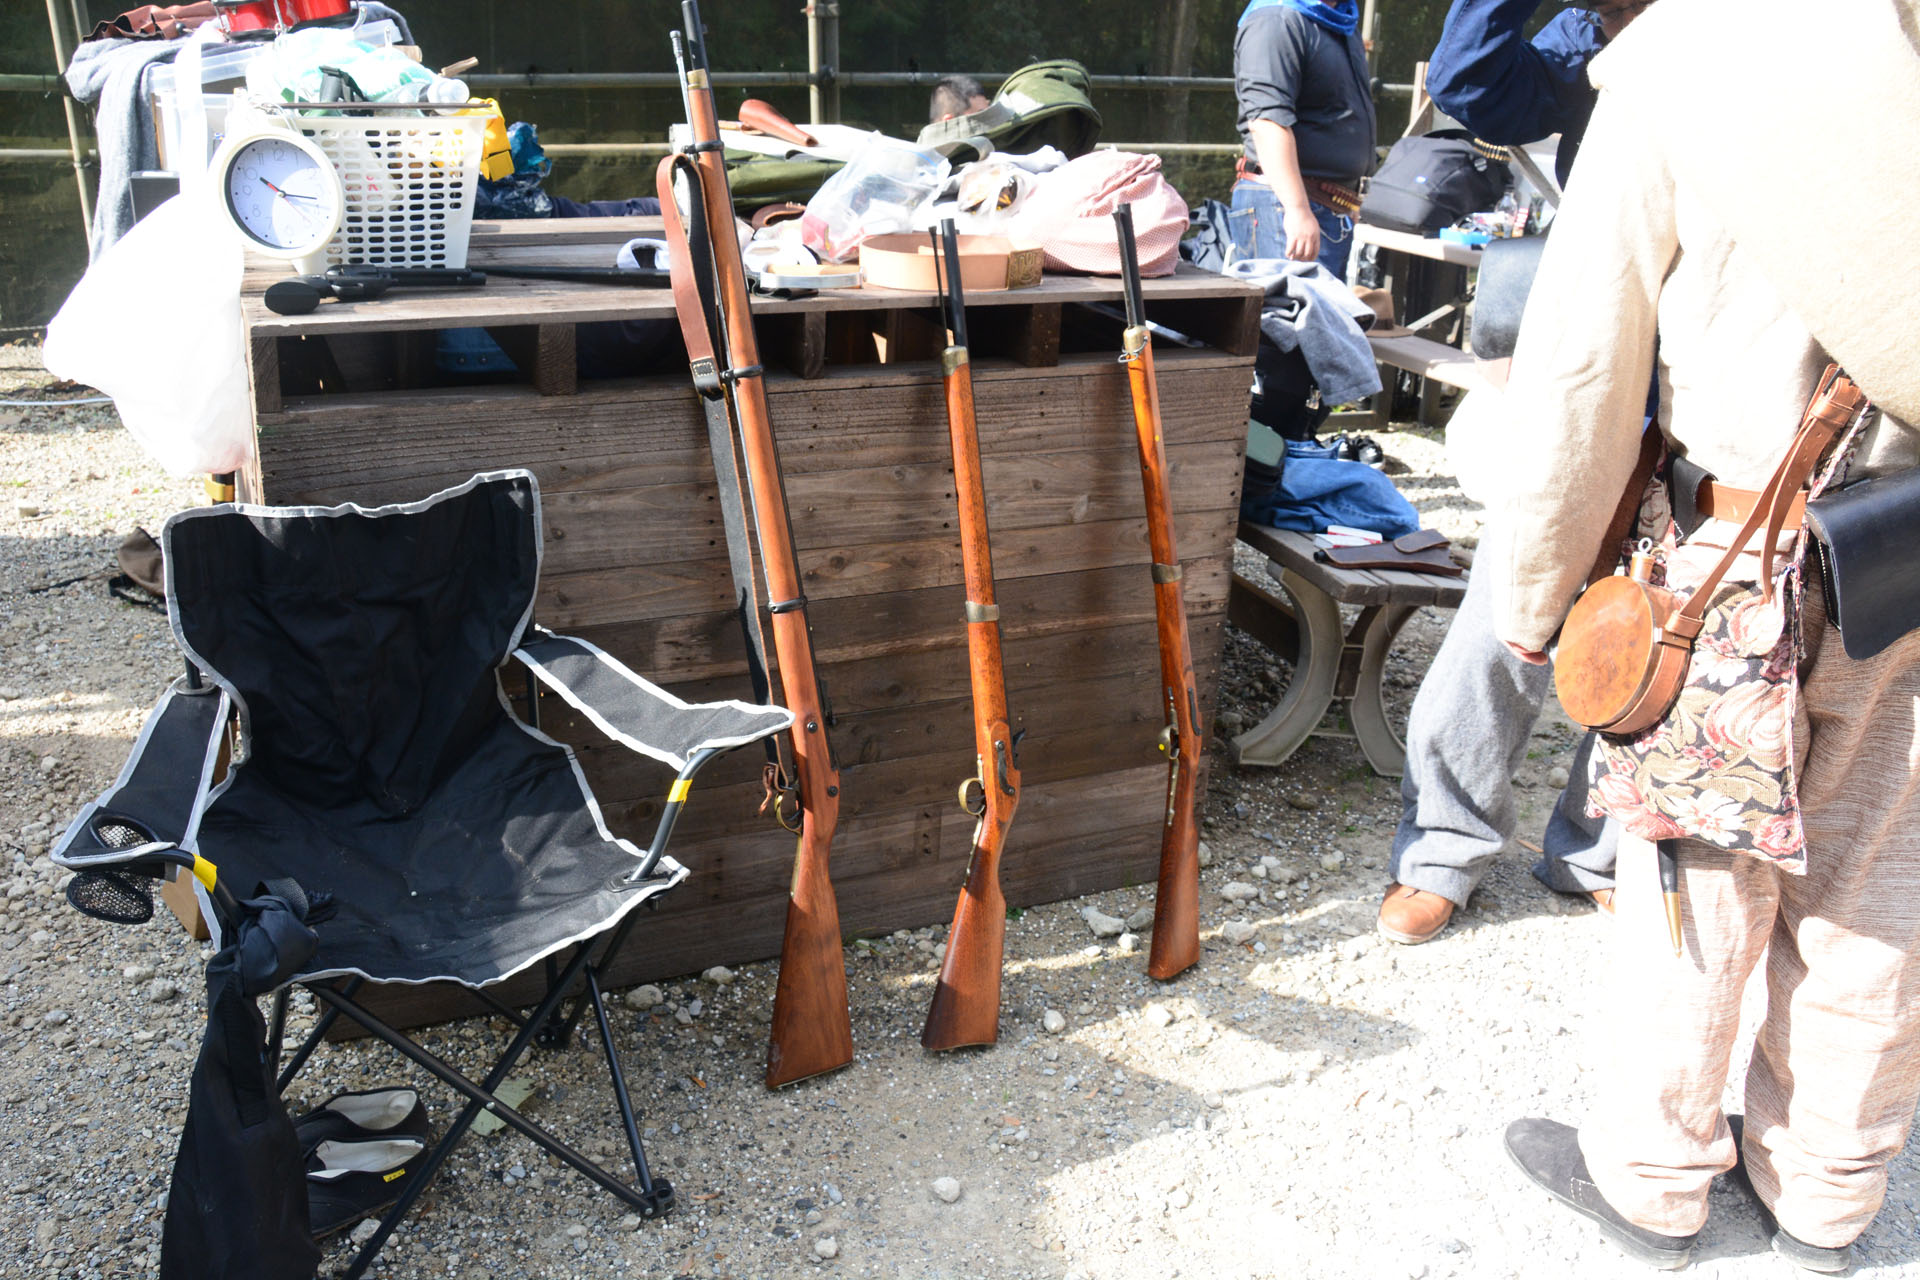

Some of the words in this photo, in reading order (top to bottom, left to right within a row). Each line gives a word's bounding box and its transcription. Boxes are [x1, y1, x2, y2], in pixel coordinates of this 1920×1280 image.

[257, 152, 264, 165] 11
[274, 148, 286, 161] 12
[252, 204, 261, 217] 8
